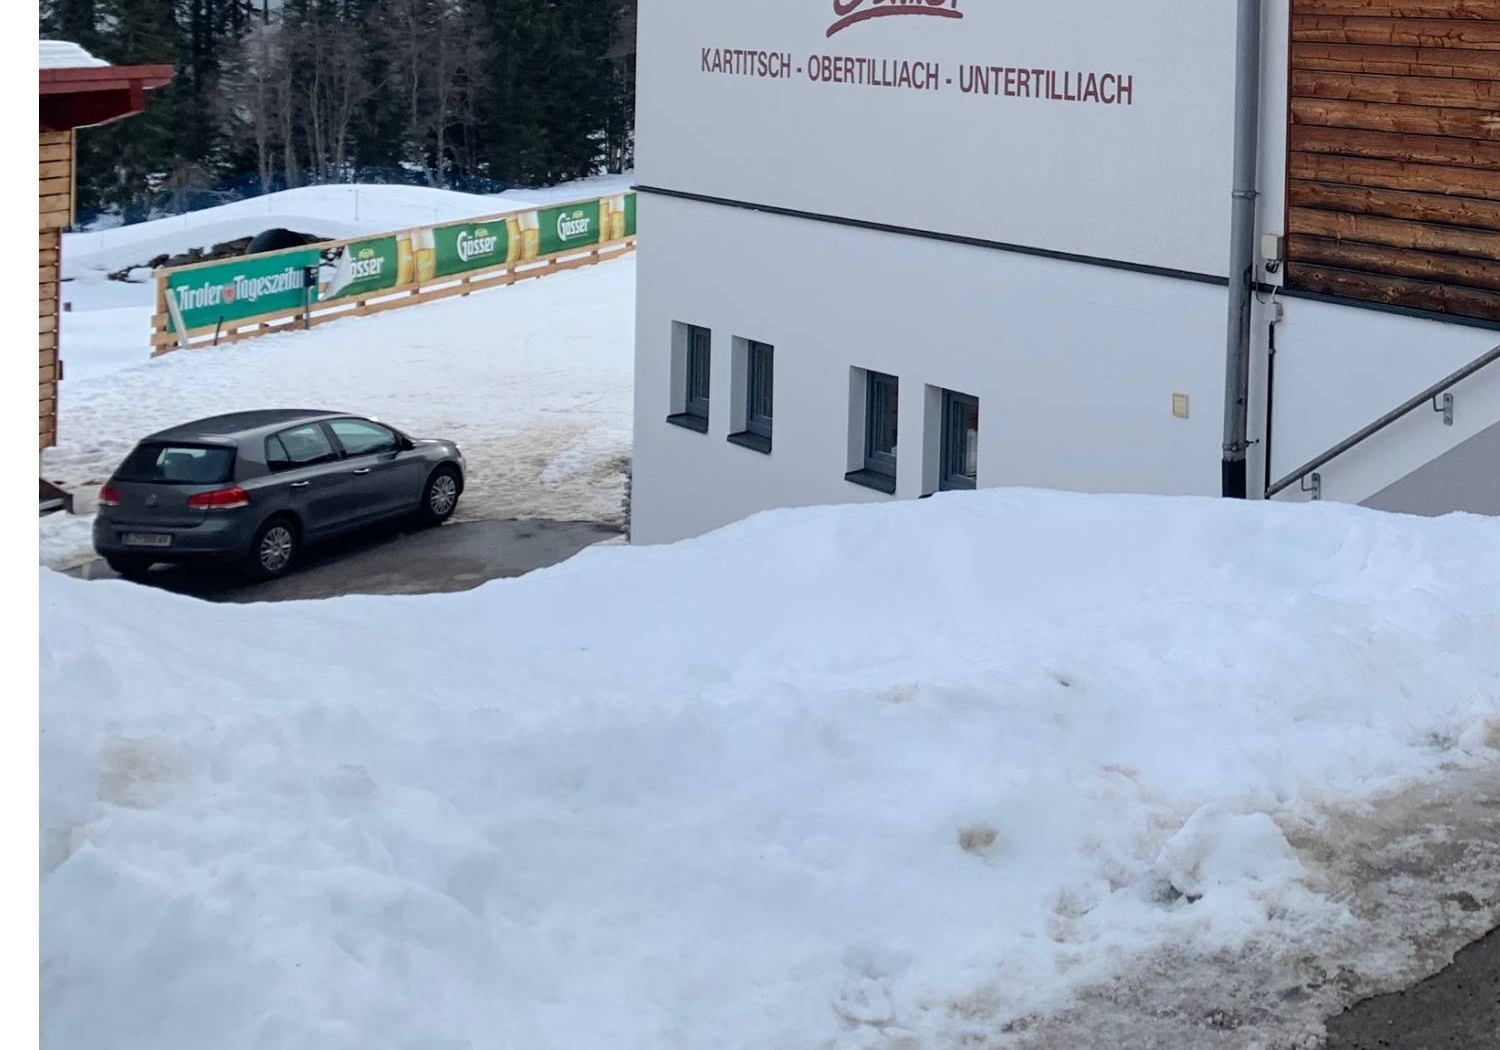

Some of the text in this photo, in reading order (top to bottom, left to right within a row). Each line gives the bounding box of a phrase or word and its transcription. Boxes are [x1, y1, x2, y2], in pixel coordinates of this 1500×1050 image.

[701, 47, 791, 78] KARTITSCH
[807, 54, 939, 90] OBERTILLIACH
[959, 65, 1133, 105] UNTERTILLIACH
[557, 212, 591, 242] Gösser
[456, 231, 496, 262] Gösser
[351, 256, 384, 279] össer
[176, 267, 305, 311] Tiroler Tageszeitu
